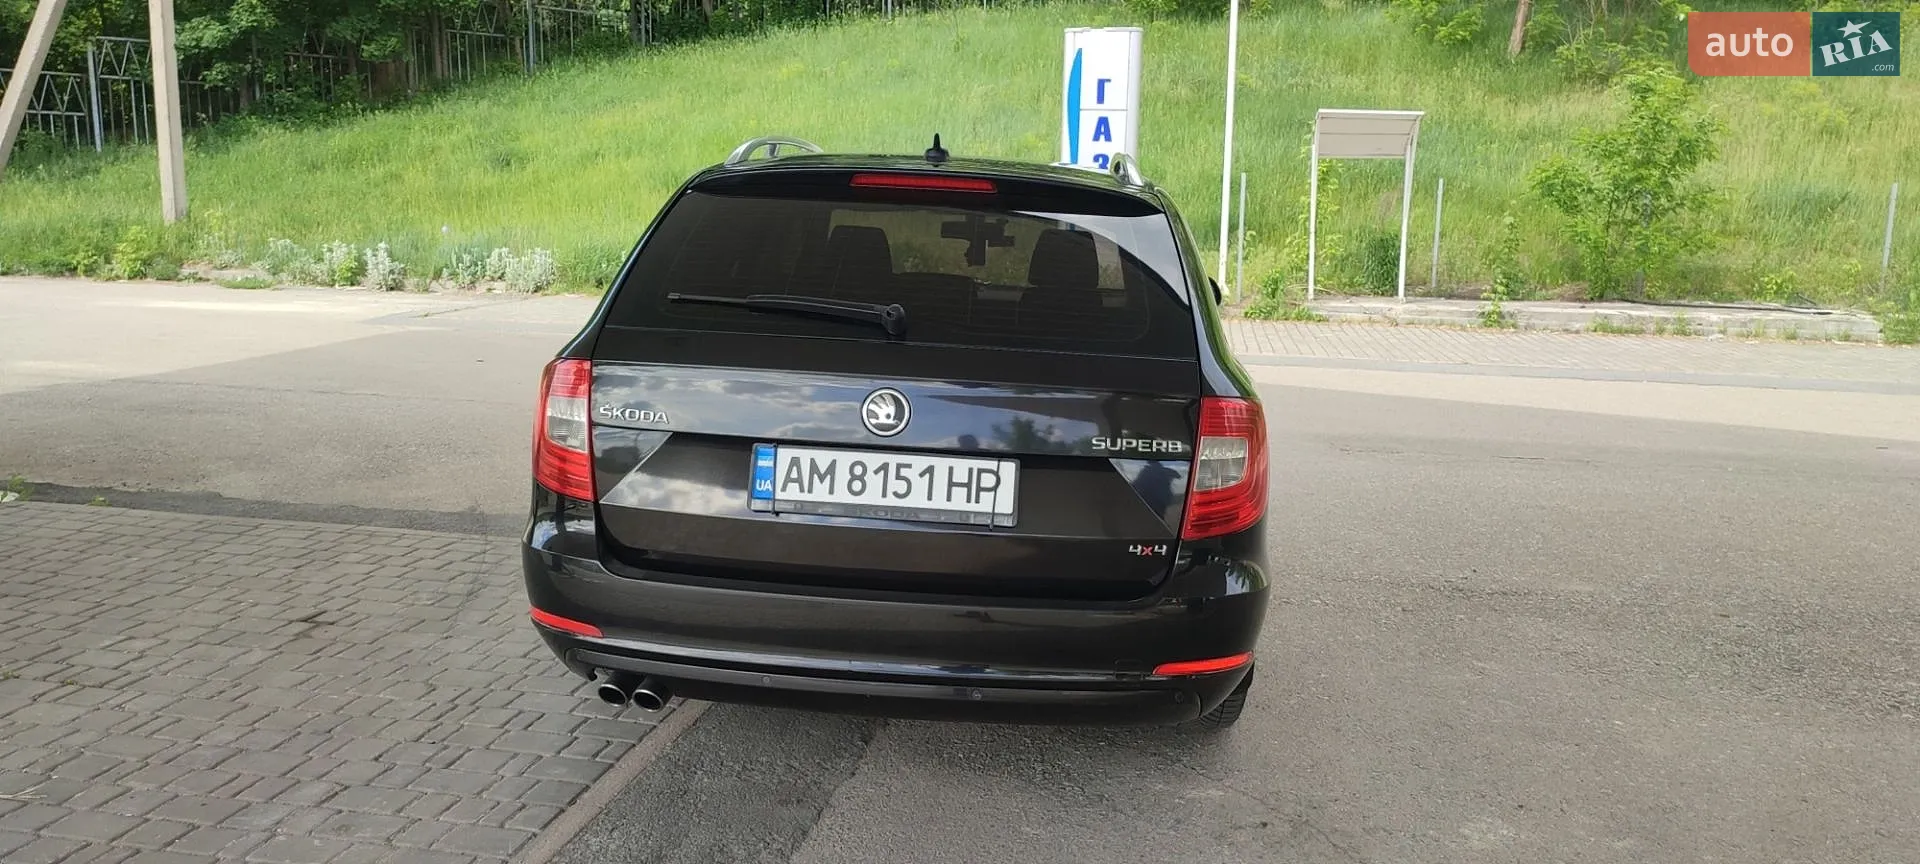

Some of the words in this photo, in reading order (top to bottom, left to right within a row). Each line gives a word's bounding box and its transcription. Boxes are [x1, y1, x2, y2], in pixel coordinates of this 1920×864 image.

[600, 403, 669, 424] ŠKODA
[1091, 436, 1183, 452] SUPERB
[756, 479, 773, 491] UA
[780, 456, 837, 495] AM
[847, 460, 935, 502] 8151
[946, 465, 1001, 504] HP
